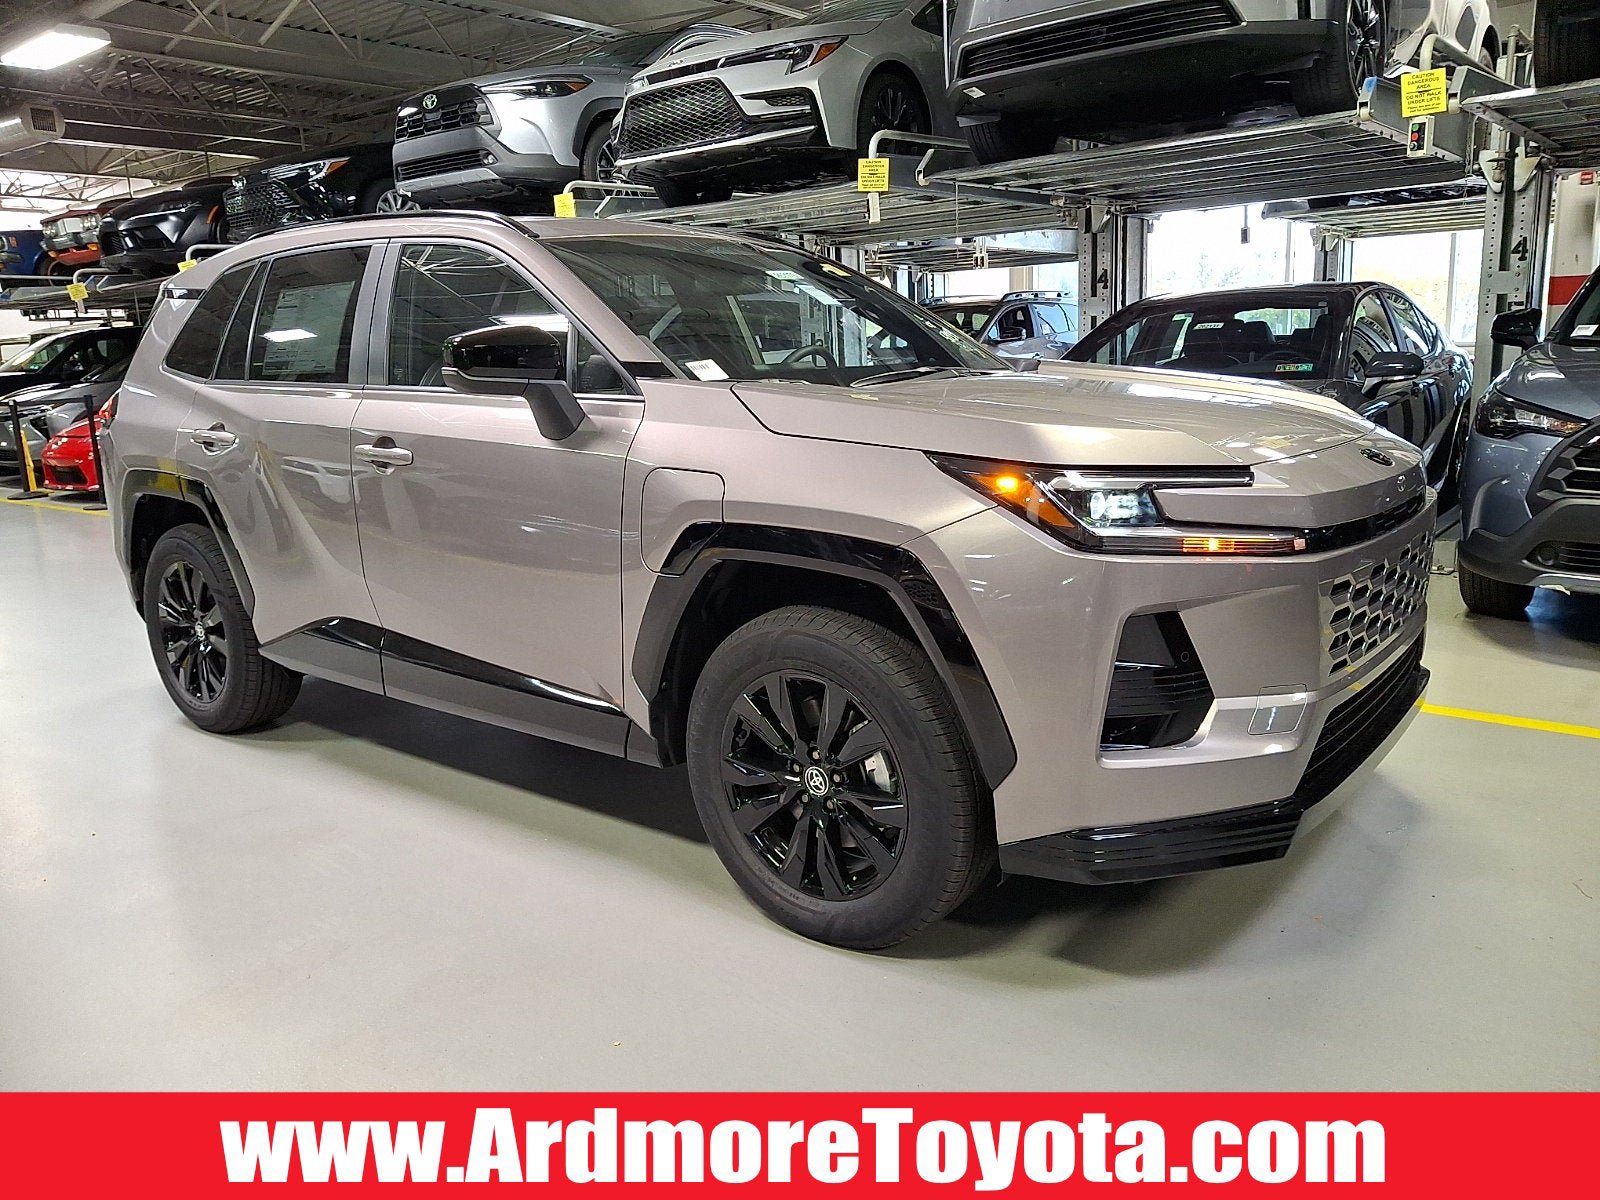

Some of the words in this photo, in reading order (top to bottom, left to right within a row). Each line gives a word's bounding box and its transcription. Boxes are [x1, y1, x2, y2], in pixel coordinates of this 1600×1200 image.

[1407, 77, 1439, 85] DANGEROUS
[1510, 236, 1528, 262] 4
[1097, 269, 1108, 289] 4
